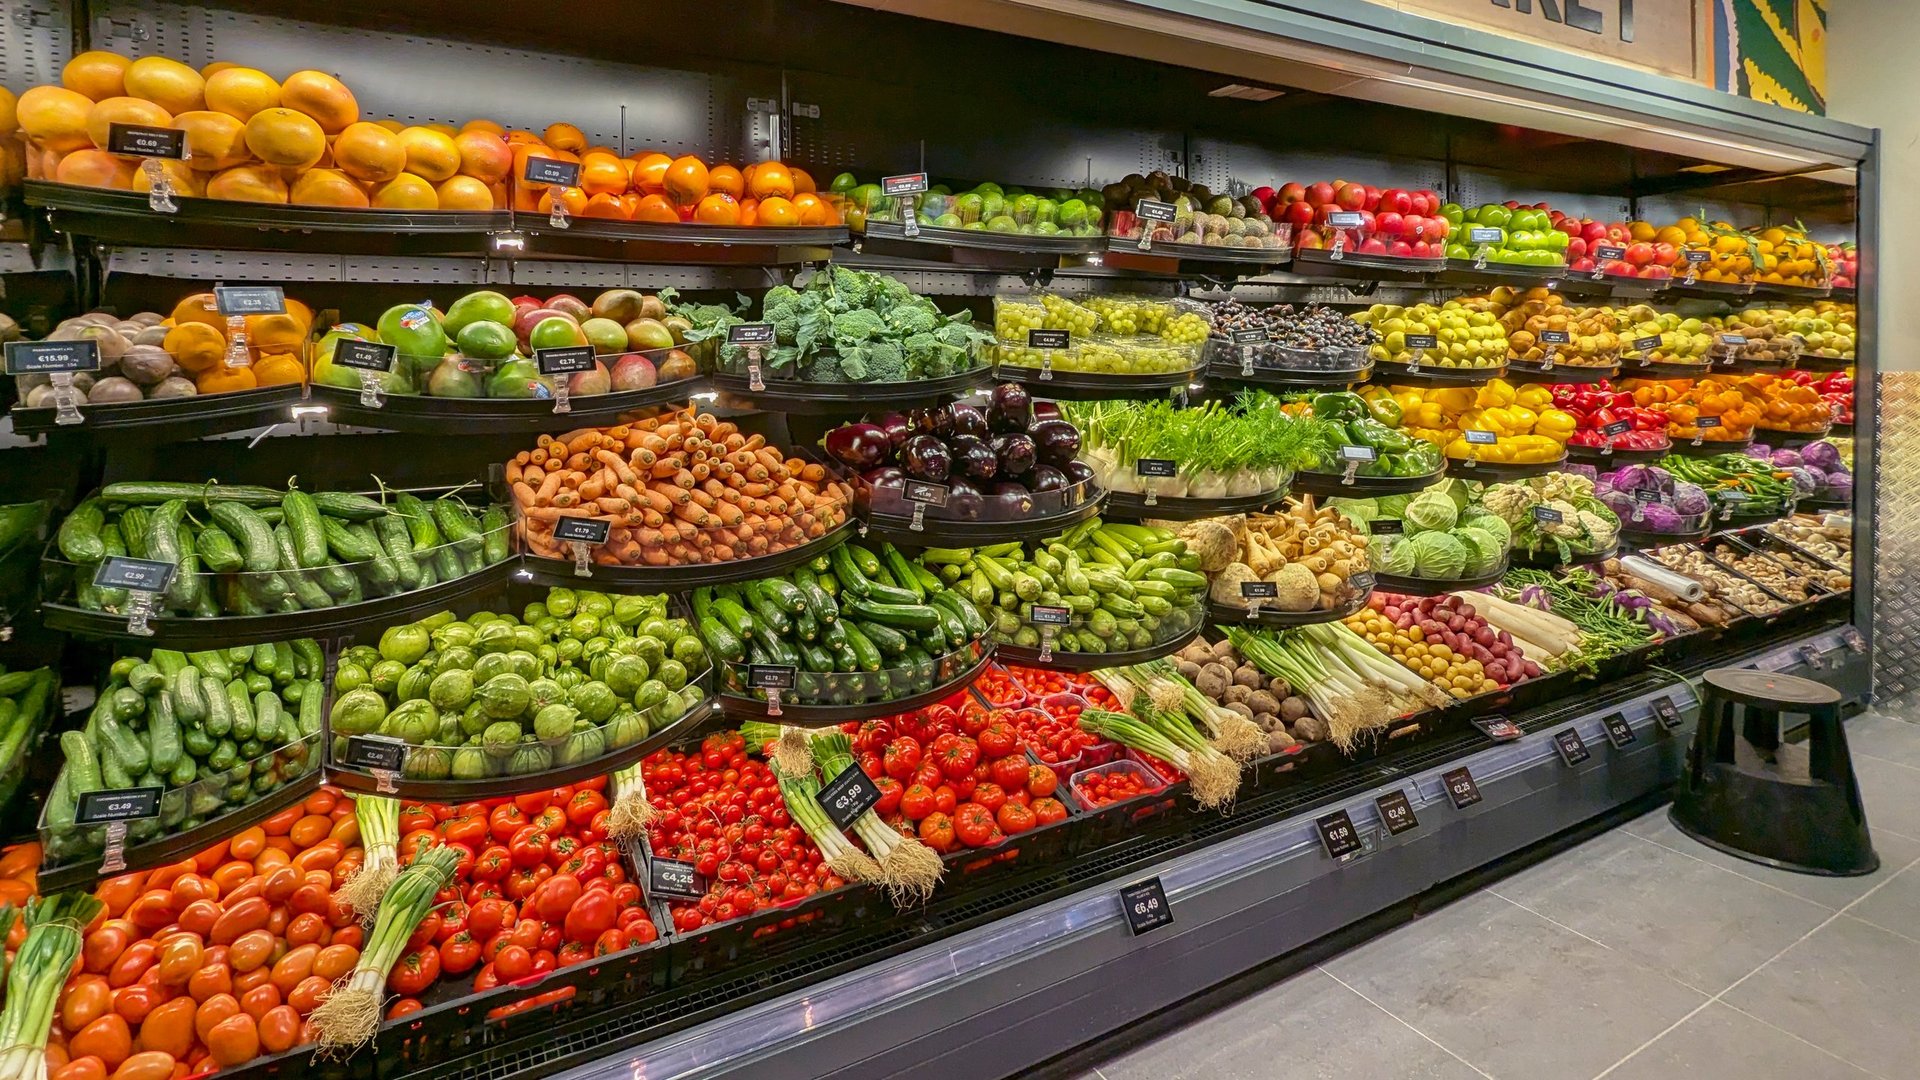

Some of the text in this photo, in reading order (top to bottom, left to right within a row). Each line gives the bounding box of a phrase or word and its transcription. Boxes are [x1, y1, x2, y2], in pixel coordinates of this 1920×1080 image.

[136, 139, 157, 147] €0.69
[38, 355, 69, 363] €15.99
[355, 353, 372, 361] €1.49
[574, 526, 589, 534] €1.79
[124, 571, 144, 580] €2.99
[1453, 782, 1470, 794] €2,25
[836, 783, 862, 810] €3,99
[108, 803, 132, 811] €3.49
[1388, 806, 1406, 819] €2,49
[1329, 827, 1349, 841] €1,59
[662, 871, 694, 884] €4,25
[1134, 897, 1159, 915] €6,49
